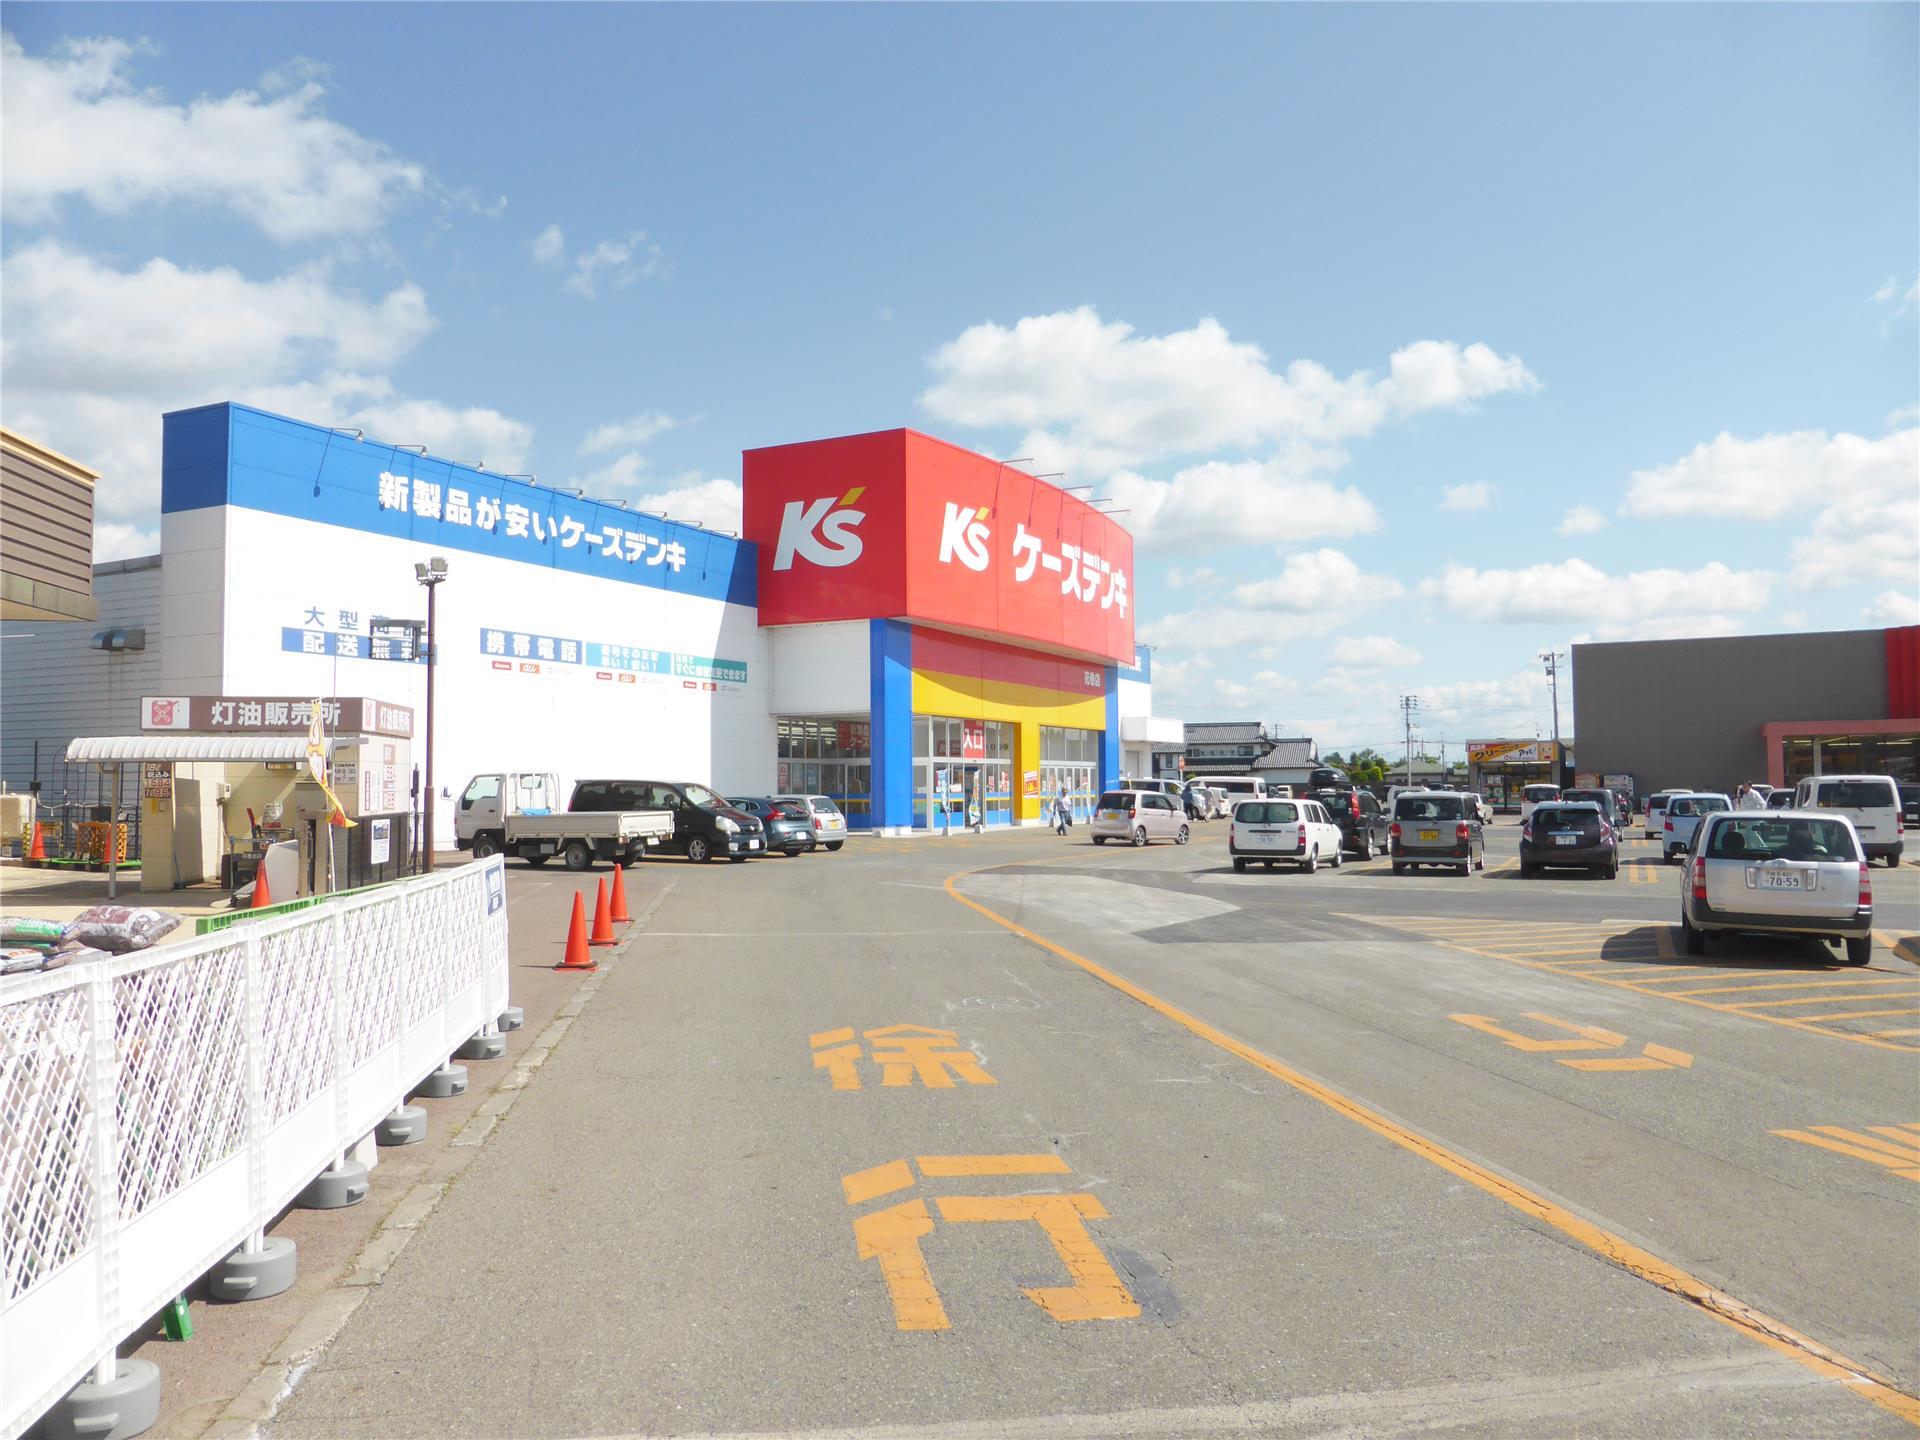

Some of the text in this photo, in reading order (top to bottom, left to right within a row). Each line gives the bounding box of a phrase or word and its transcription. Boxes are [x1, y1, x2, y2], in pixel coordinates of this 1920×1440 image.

[379, 471, 687, 572] 新製品が安いケーズデンキ
[773, 487, 866, 572] K's
[939, 502, 1128, 619] K's ケーズデンキ
[211, 700, 342, 726] 灯油販売所
[963, 728, 983, 750] 入口
